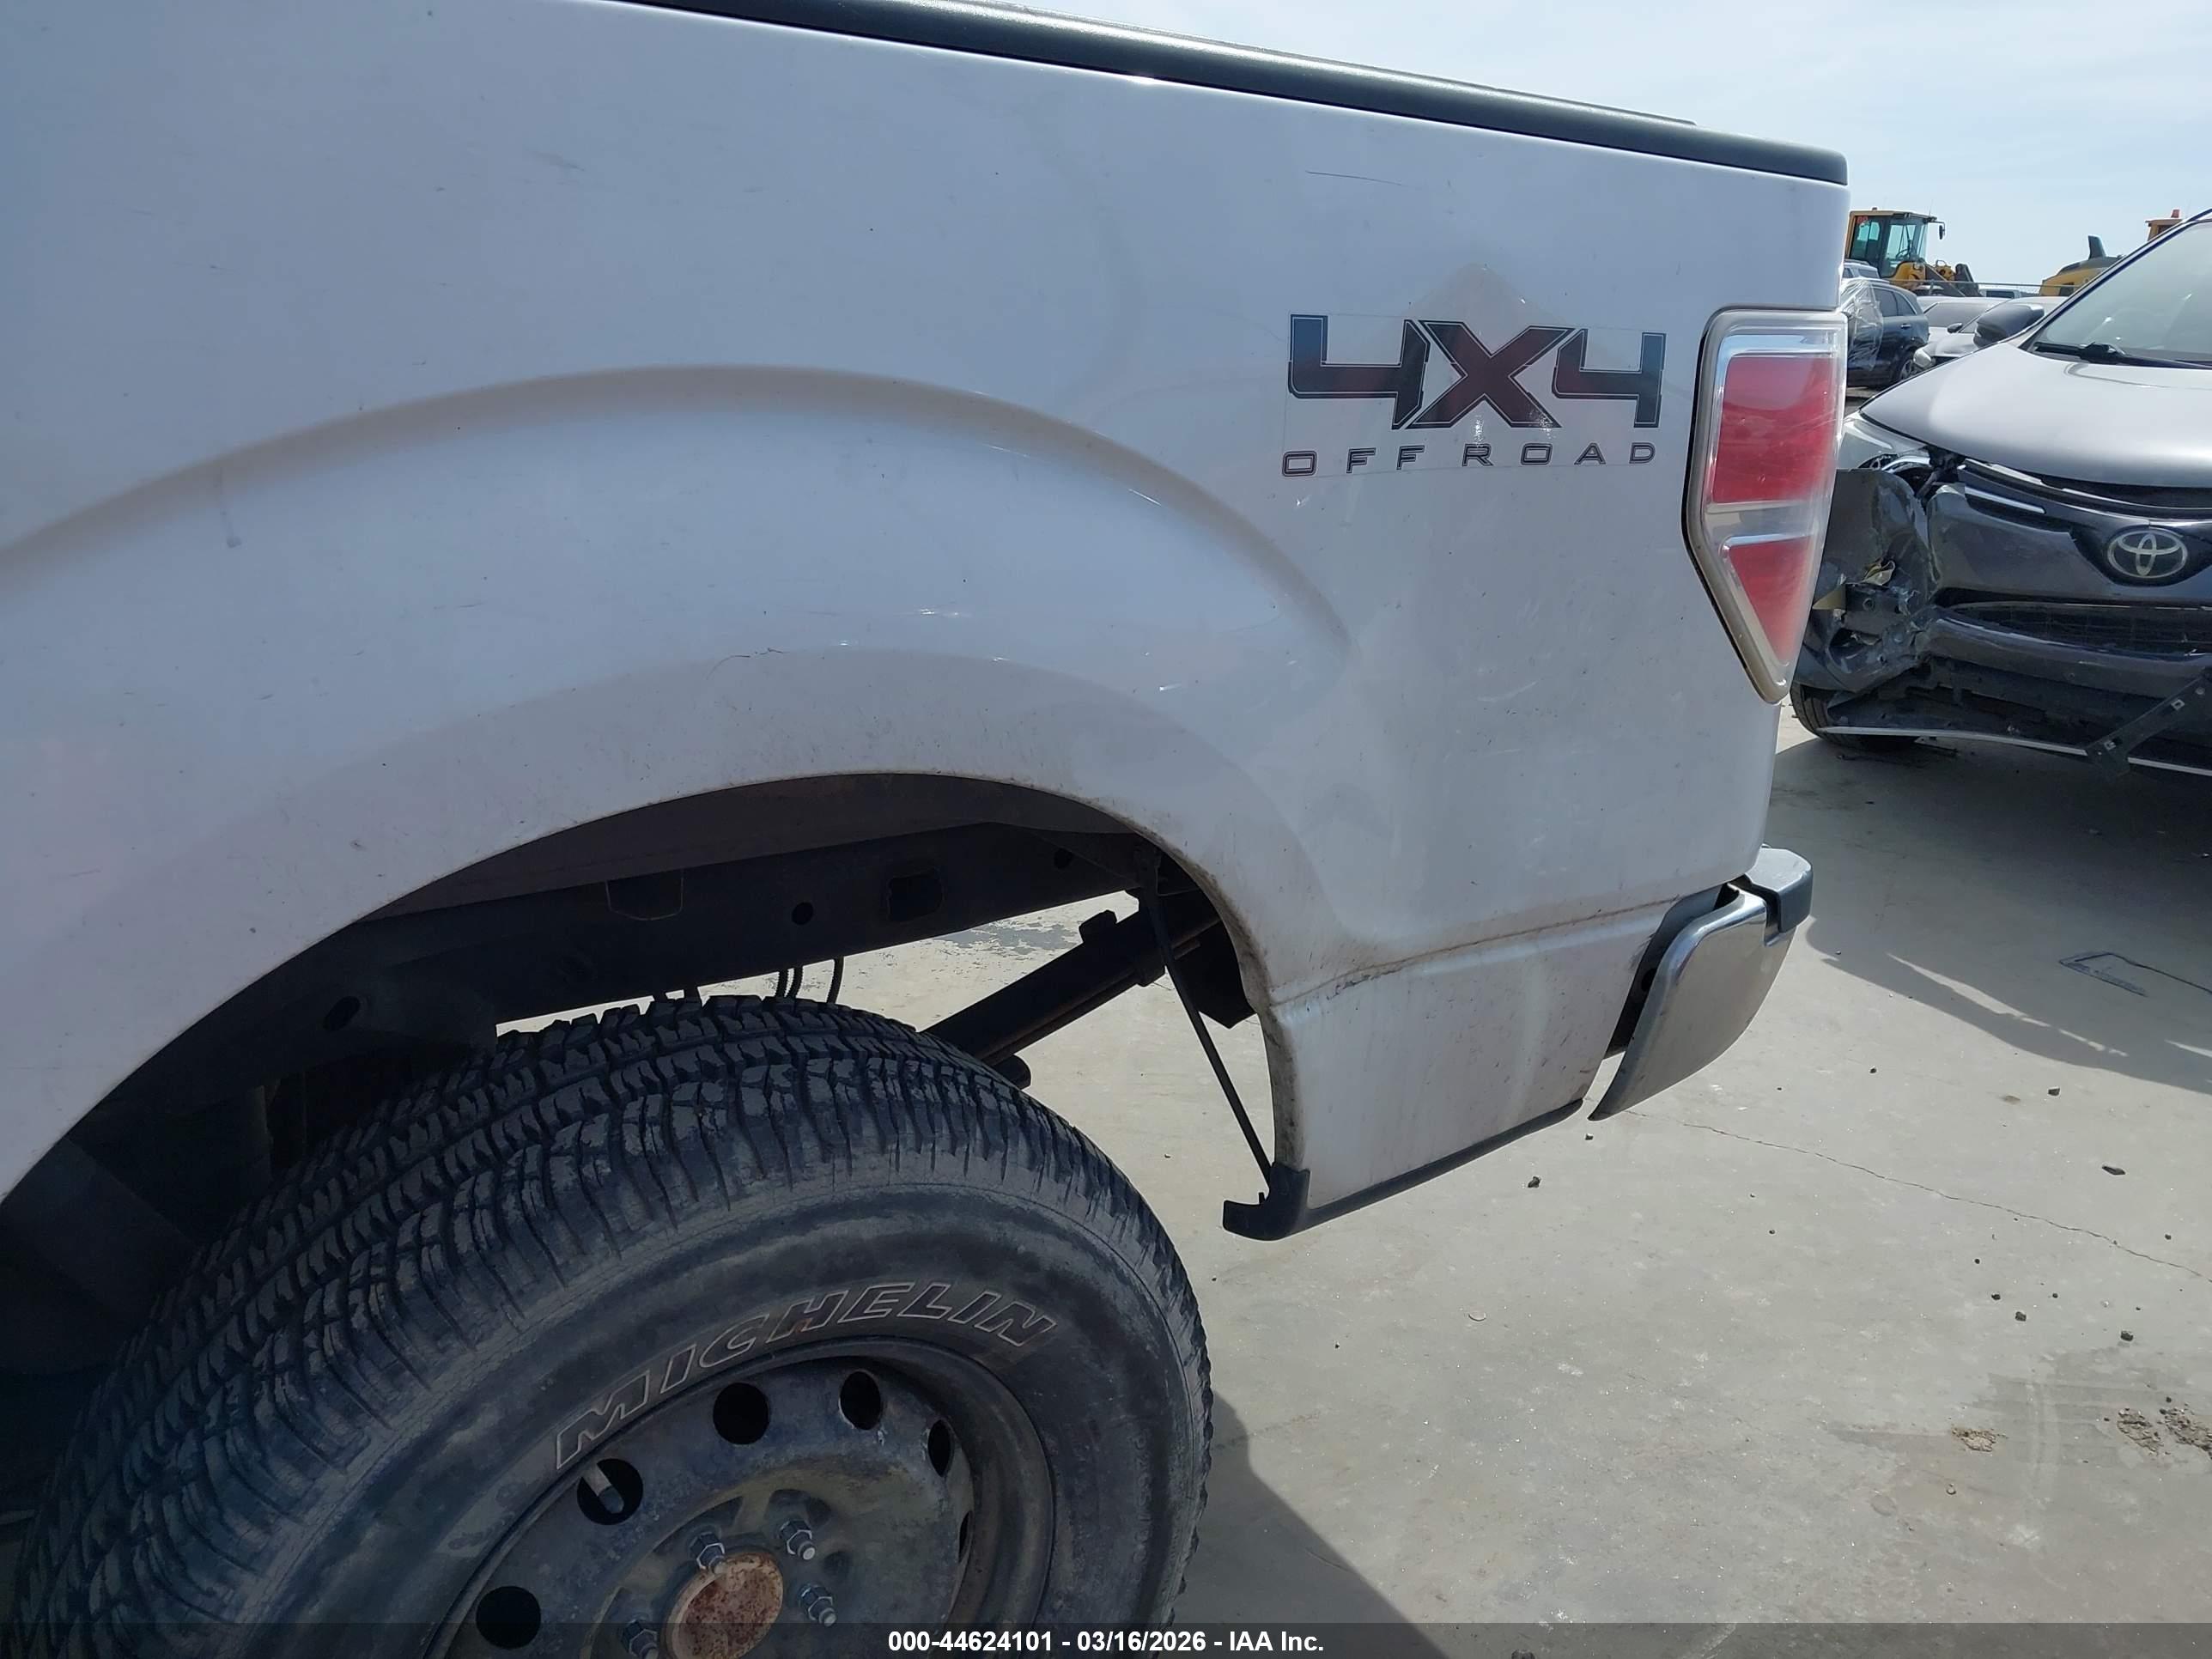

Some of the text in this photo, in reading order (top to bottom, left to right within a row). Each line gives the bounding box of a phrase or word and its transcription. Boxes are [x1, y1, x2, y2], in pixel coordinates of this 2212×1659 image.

[1288, 314, 1666, 429] 4X4
[1282, 442, 1656, 477] OFF ROAD
[556, 1282, 1058, 1469] MICHELIN
